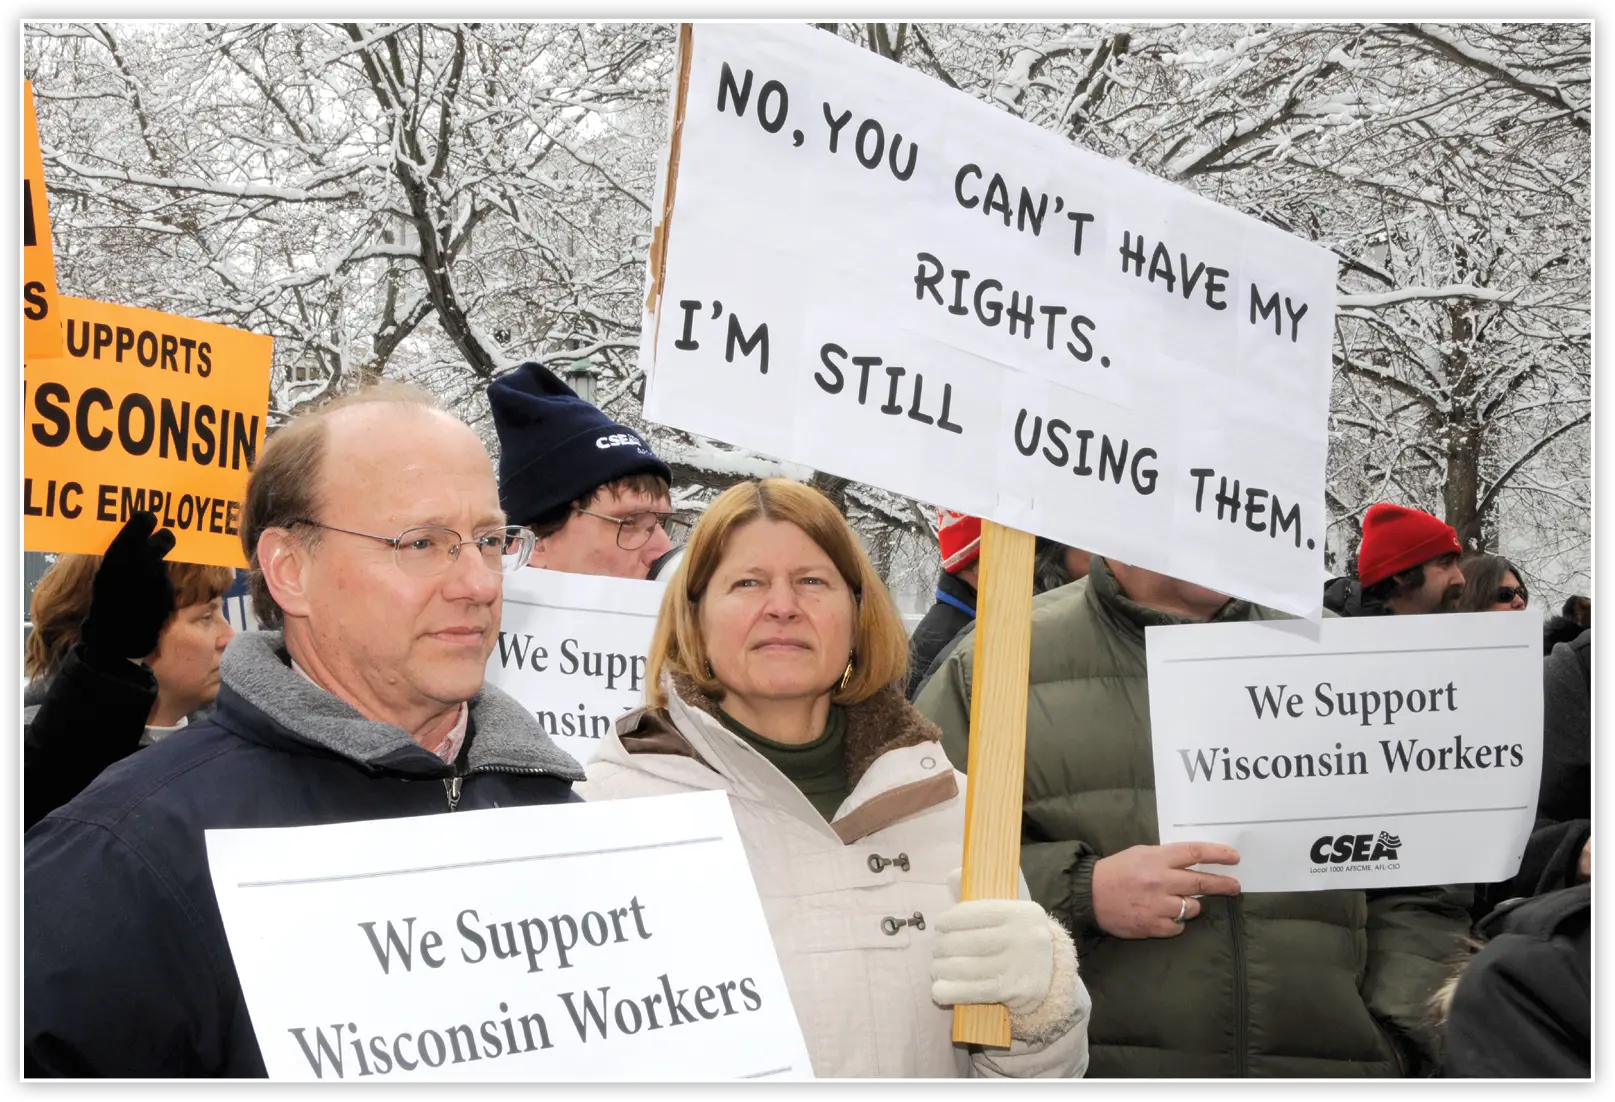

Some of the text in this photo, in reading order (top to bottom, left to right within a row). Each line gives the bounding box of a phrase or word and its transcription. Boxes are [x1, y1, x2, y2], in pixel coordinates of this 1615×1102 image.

[823, 102, 918, 181] YOU
[955, 164, 1094, 256] CAN'T
[1120, 231, 1229, 310] HAVE
[1250, 283, 1308, 343] MY
[914, 253, 1111, 368] RIGHTS.
[61, 319, 211, 378] UPPORTS
[24, 379, 259, 470] SCONSIN
[675, 300, 1315, 550] I'M STILL USING THEM.
[498, 631, 549, 673] We
[1245, 681, 1458, 726] We Support
[1178, 735, 1523, 783] Wisconsin Workers
[1310, 831, 1402, 864] CSEA
[1310, 866, 1328, 874] Local
[358, 896, 653, 975] We Support
[287, 973, 762, 1079] Wisconsin Workers
